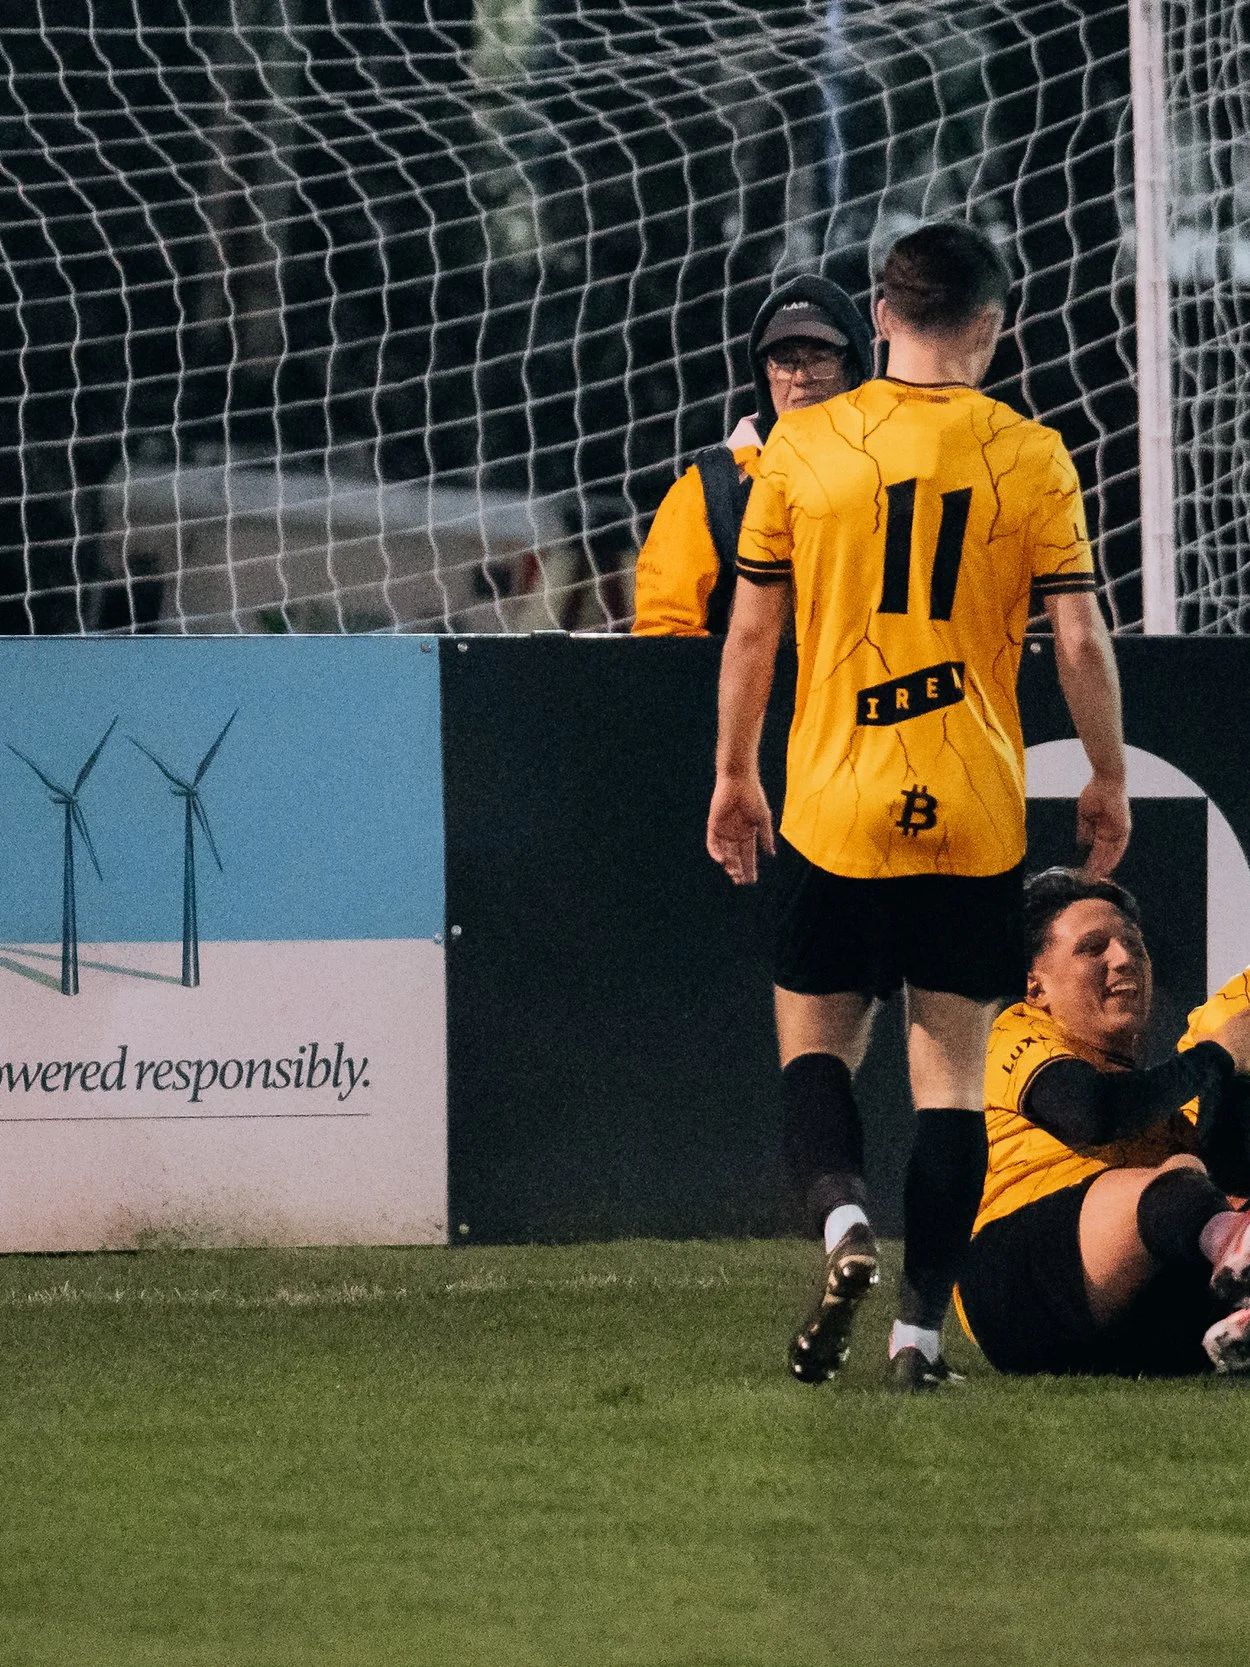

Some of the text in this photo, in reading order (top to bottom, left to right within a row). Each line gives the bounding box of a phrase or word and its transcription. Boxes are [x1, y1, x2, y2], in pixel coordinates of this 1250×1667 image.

[877, 477, 973, 622] 11
[0, 1041, 371, 1103] wered responsibly.
